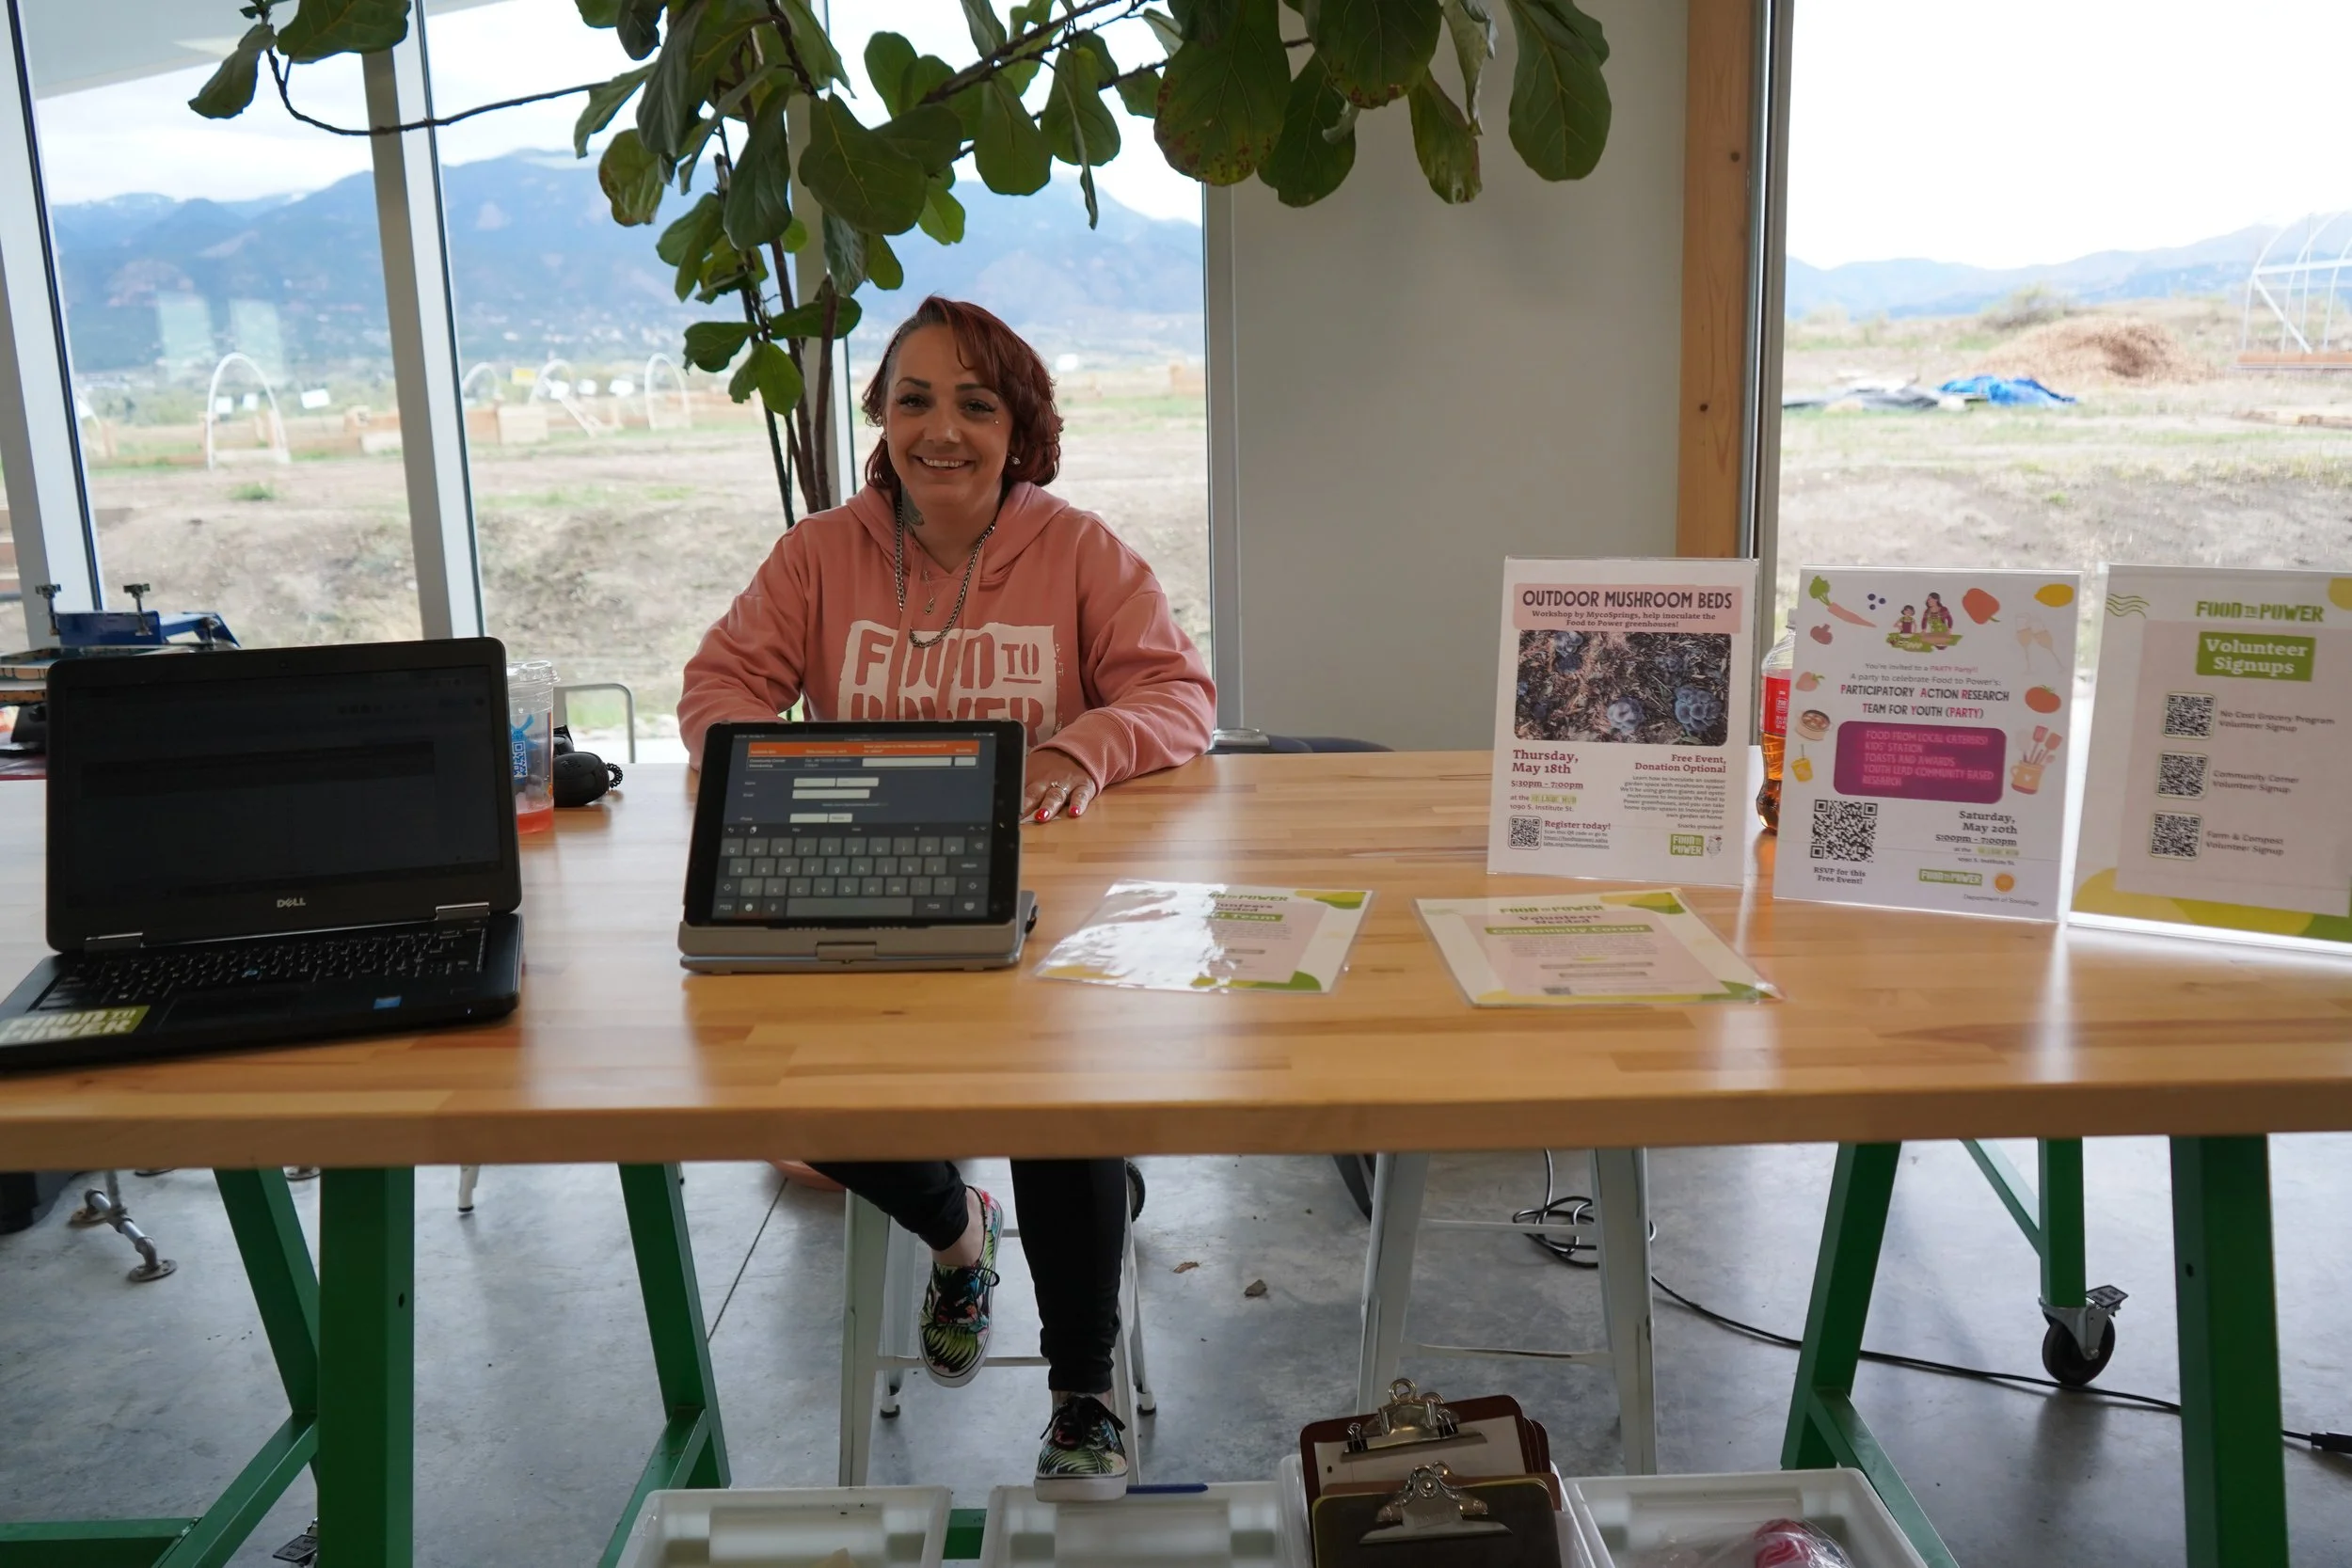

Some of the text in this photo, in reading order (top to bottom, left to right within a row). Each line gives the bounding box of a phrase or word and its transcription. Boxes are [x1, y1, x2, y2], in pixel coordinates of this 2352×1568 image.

[1522, 591, 1732, 609] OUTDOOR MUSHROOM BEDS
[1586, 611, 1641, 620] MycoSprings,
[1644, 612, 1661, 621] help
[2196, 601, 2242, 618] FOOD
[2260, 604, 2324, 622] POWER
[2205, 639, 2308, 657] Volunteer
[1001, 642, 1040, 684] TO
[2214, 657, 2294, 677] Signups
[1840, 684, 2010, 701] PARTICIPATORY ACTION RESEARCH
[1863, 704, 1984, 719] TEAM FOR YOUTH (PARTY)
[2258, 713, 2293, 722] Grocery
[2296, 715, 2335, 725] Program
[2219, 721, 2297, 733] Volunteer Signup
[1866, 730, 1890, 740] FOOD
[1892, 731, 1917, 741] FROM
[1918, 733, 1944, 743] LOCAL
[1888, 743, 1923, 752] STATION
[1513, 750, 1579, 764] Thursday,
[1694, 755, 1726, 765] Event,
[1865, 753, 1955, 767] TOASTS AND AWARDS
[1513, 763, 1571, 775] May 18th
[1635, 762, 1725, 774] Donation Optional
[1864, 764, 1994, 780] YOUTH LEAD COMMUNITY BASED
[2214, 770, 2299, 784] Community Corner
[1550, 782, 1583, 790] 7:00pm
[2213, 781, 2291, 794] Volunteer Signup
[1959, 811, 2015, 824] Saturday,
[1545, 820, 1611, 832] Register today!
[1963, 822, 2017, 834] May 20th
[1935, 834, 2017, 847] 5:00pm 7:00pm
[2207, 831, 2230, 839] Farm
[2242, 834, 2283, 845] Compost
[2206, 842, 2284, 856] Volunteer Signup
[277, 897, 307, 908] DELL
